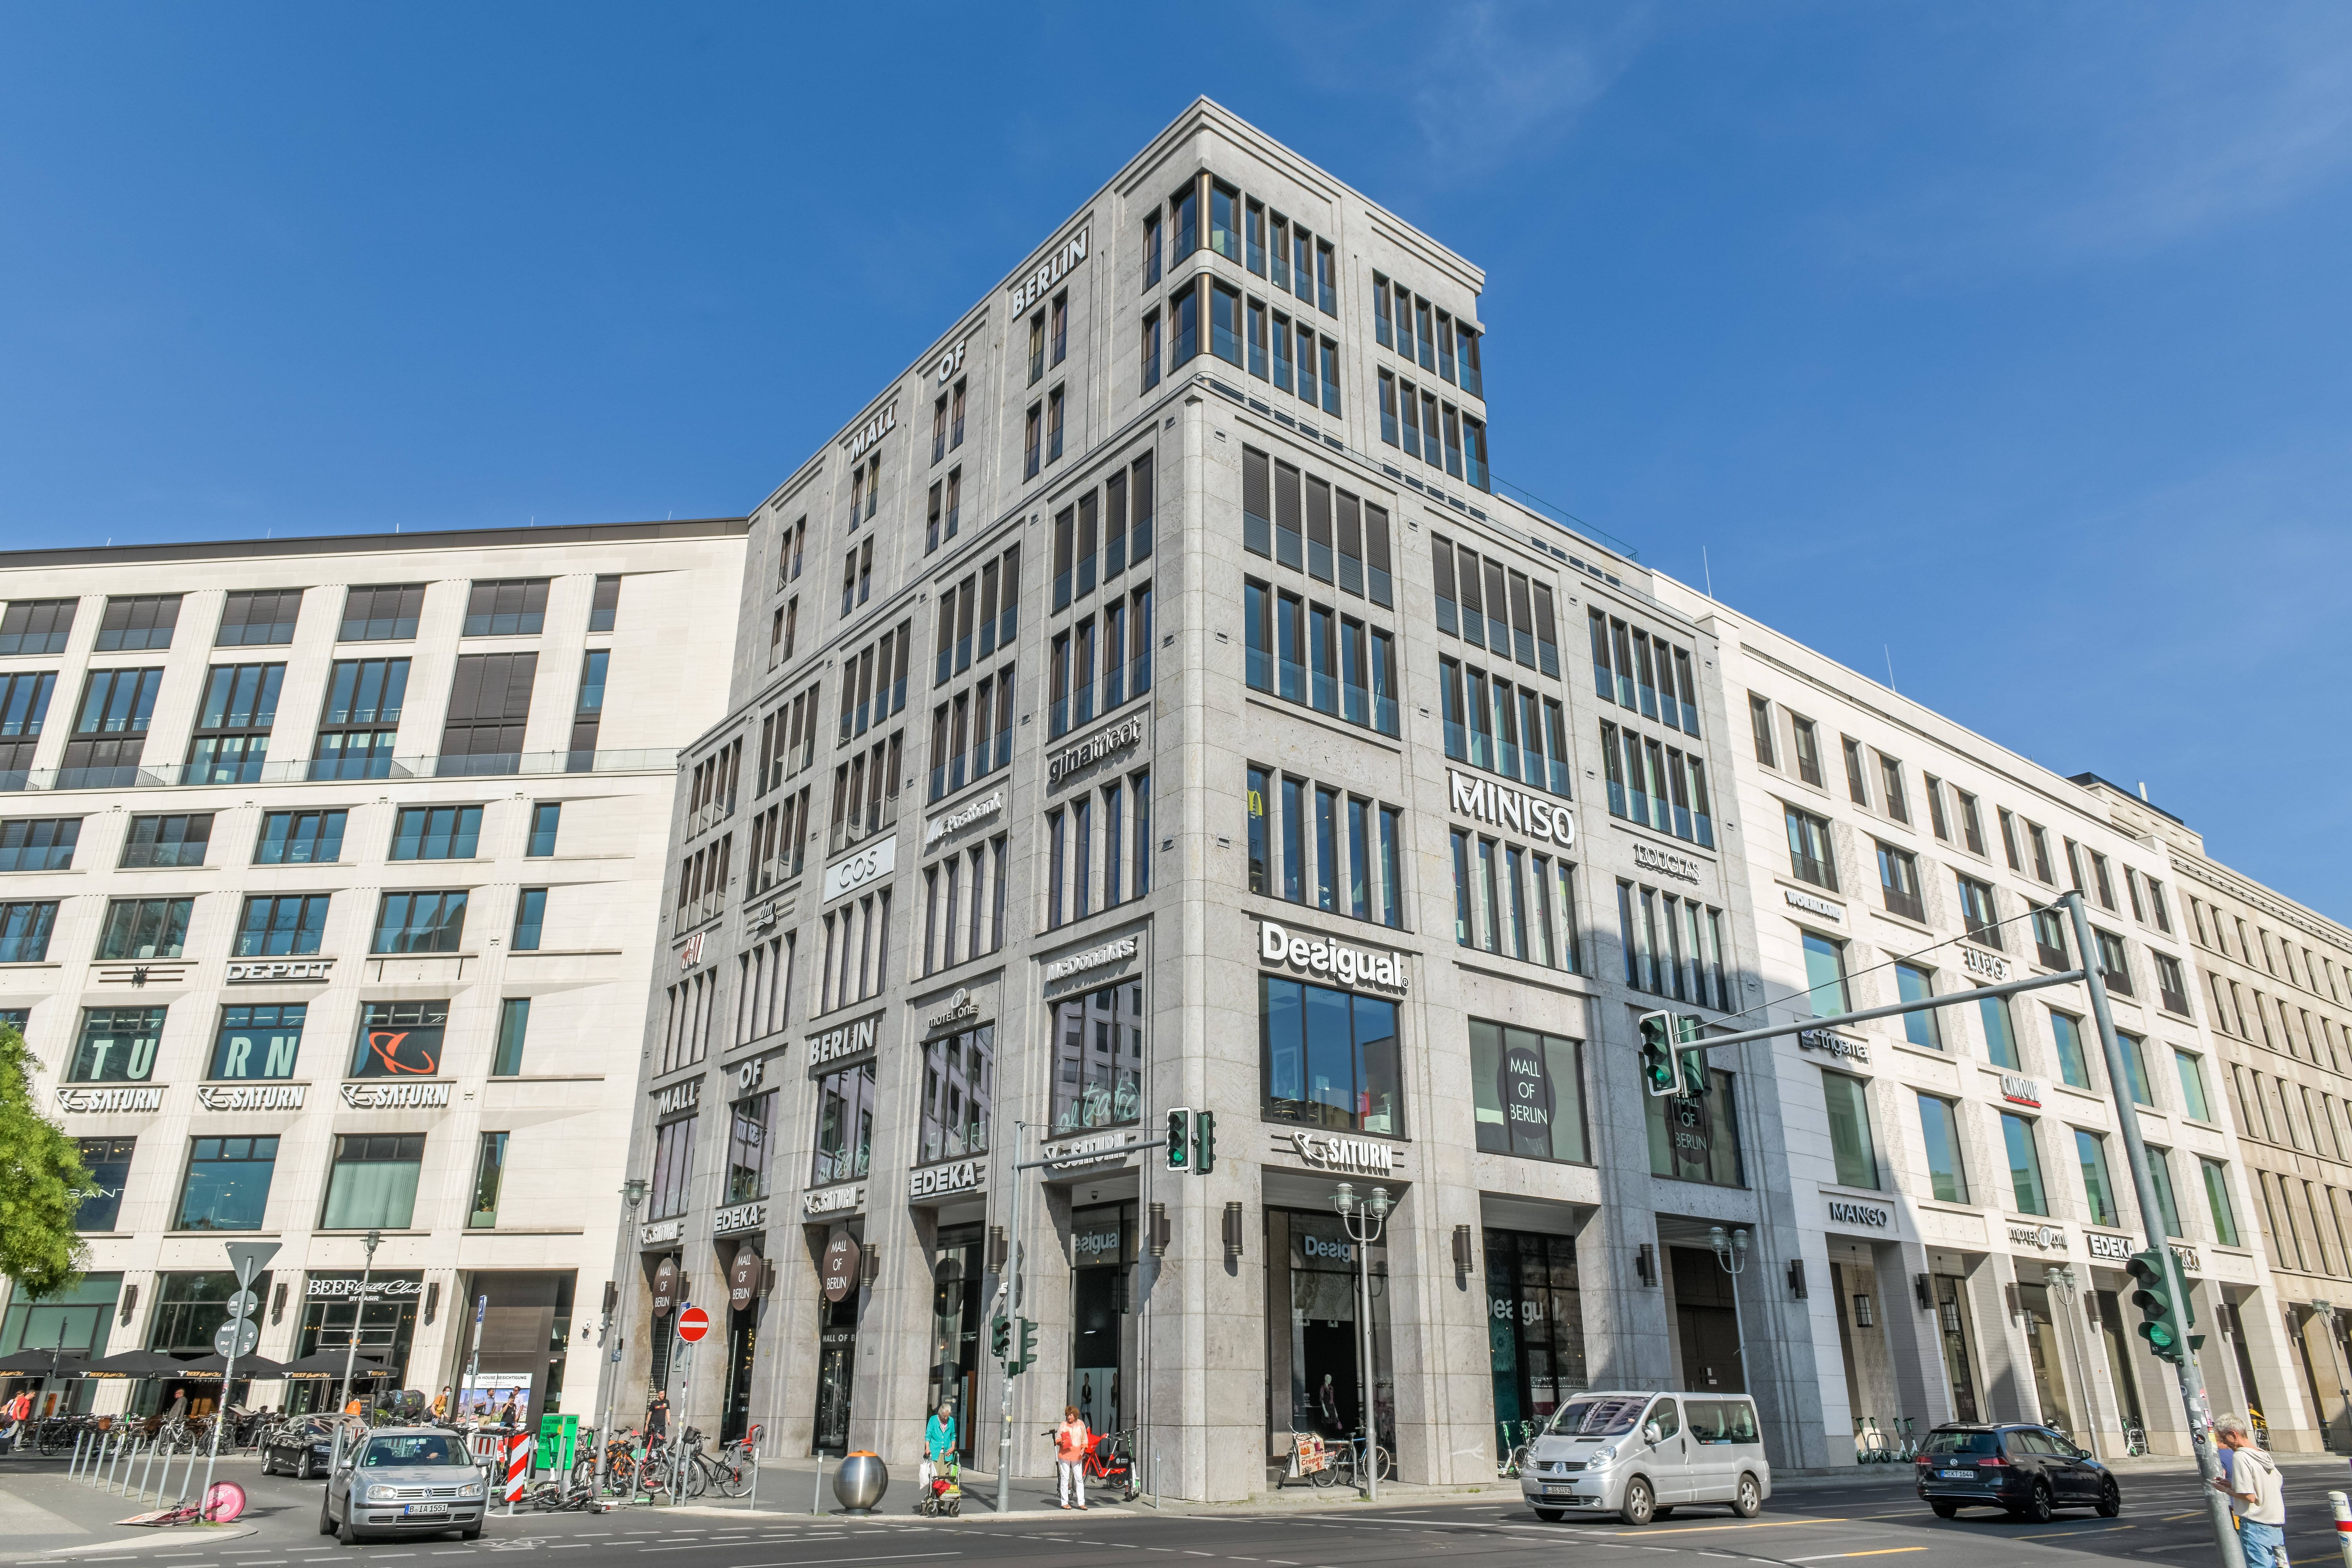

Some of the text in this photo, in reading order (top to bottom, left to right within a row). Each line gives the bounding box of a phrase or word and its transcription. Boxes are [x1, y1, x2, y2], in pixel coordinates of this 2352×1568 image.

[851, 230, 1088, 463] MALL OF BERLIN
[947, 792, 1002, 834] Postbank
[1452, 770, 1575, 844] MINISO
[839, 850, 877, 889] COS
[1635, 843, 1700, 880] DOUGLAS
[1786, 891, 1841, 921] WORMLAND
[1046, 940, 1135, 982] McDonald's
[1262, 921, 1401, 987] Desigual
[226, 962, 333, 980] DEPOT
[1816, 1031, 1867, 1058] trigema
[659, 1018, 875, 1117] MALL OF BERLIN
[1510, 1056, 1541, 1078] MALL
[232, 1086, 306, 1108] SATURN
[375, 1084, 450, 1106] SATURN
[1519, 1082, 1535, 1099] OF
[2004, 1074, 2041, 1099] CINQUE
[88, 1089, 163, 1110] SATURN
[1510, 1103, 1548, 1126] BERLIN
[1681, 1112, 1695, 1128] OF
[1070, 1132, 1125, 1167] SATURN
[1676, 1132, 1707, 1151] BERLIN
[1328, 1138, 1393, 1170] SATURN
[910, 1162, 977, 1196] EDEKA
[820, 1186, 857, 1212] SATURN
[714, 1205, 760, 1232] EDEKA
[1830, 1202, 1887, 1227] MANGO
[652, 1222, 679, 1243] SATURN
[831, 1240, 847, 1253] MALL
[2092, 1235, 2135, 1258] EDEKA
[660, 1266, 671, 1276] MALL
[737, 1254, 751, 1267] MALL
[833, 1258, 842, 1271] OF
[306, 1279, 358, 1295] BEEF
[385, 1279, 423, 1294] Club
[660, 1281, 667, 1292] OF
[739, 1271, 747, 1283] OF
[827, 1276, 847, 1290] BERLIN
[655, 1296, 670, 1307] BERLIN
[733, 1287, 750, 1300] BERLIN
[1301, 1455, 1323, 1466] Crêpes
